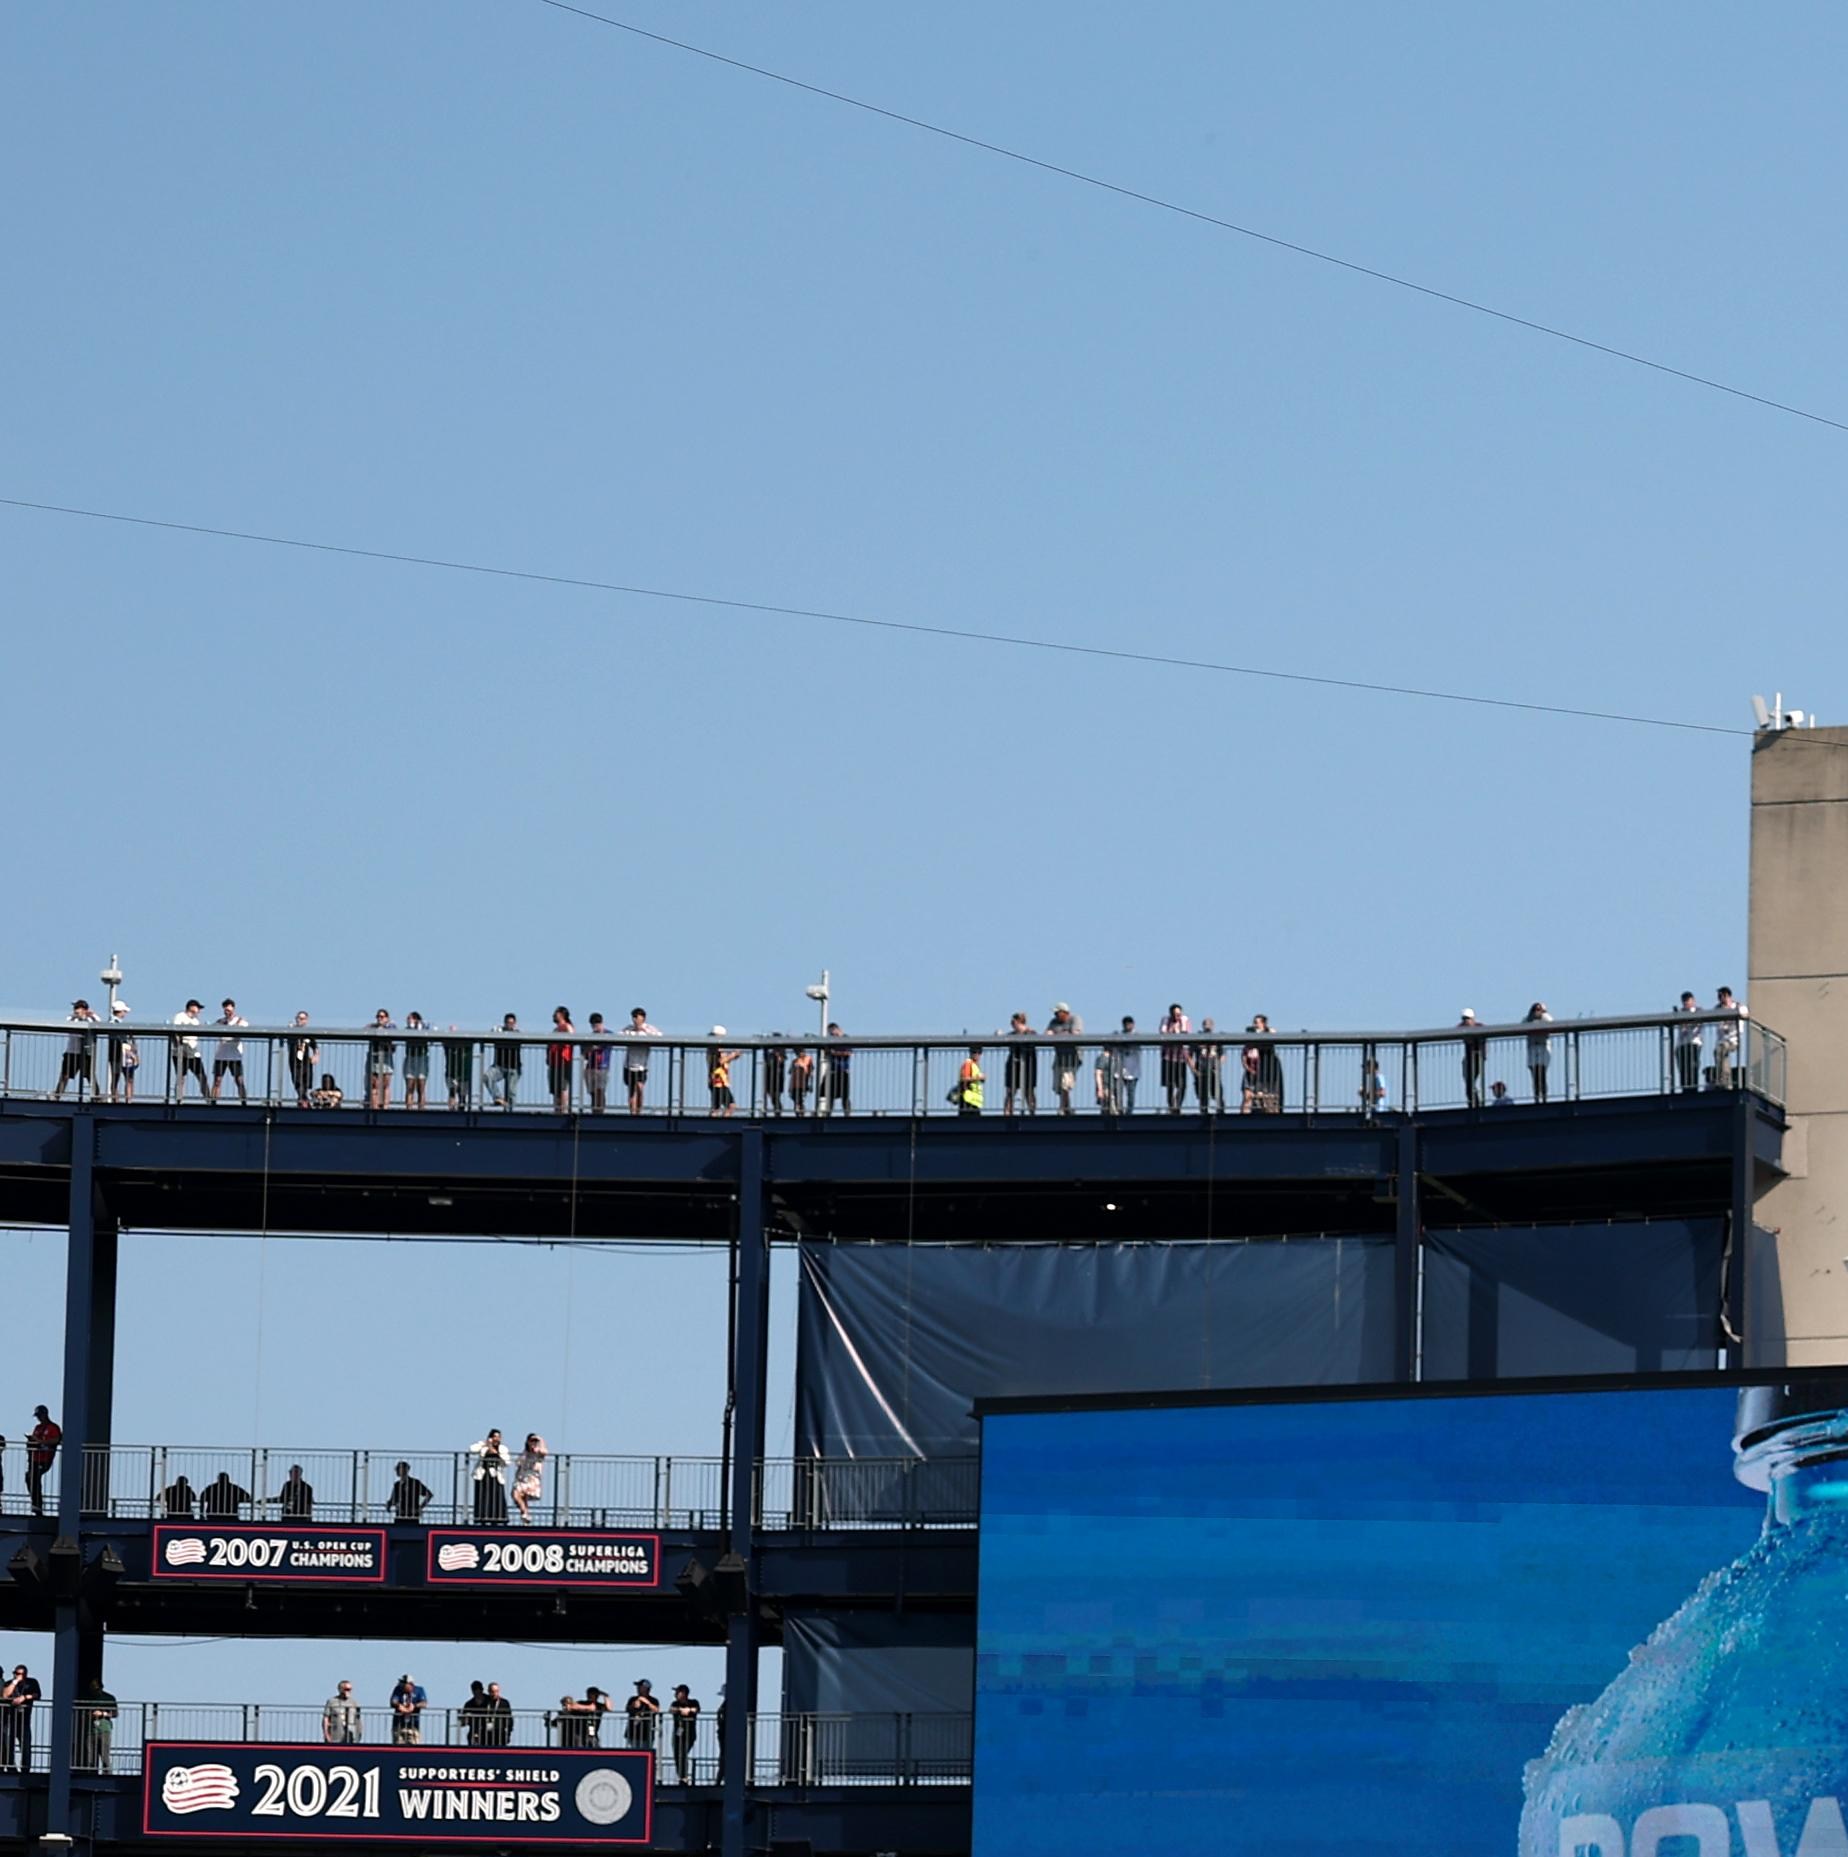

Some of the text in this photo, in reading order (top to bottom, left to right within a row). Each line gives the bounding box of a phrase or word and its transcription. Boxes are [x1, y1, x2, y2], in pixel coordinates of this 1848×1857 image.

[209, 1537, 288, 1567] 2007
[291, 1540, 373, 1552] U.S. OPEN CUP
[569, 1544, 645, 1558] SUPERLIGA
[289, 1552, 373, 1569] CHAMPIONS
[482, 1543, 564, 1573] 2008
[565, 1558, 649, 1574] CHAMPIONS
[504, 1768, 561, 1783] SHIELD
[251, 1763, 381, 1819] 2021
[398, 1789, 561, 1822] WINNERS
